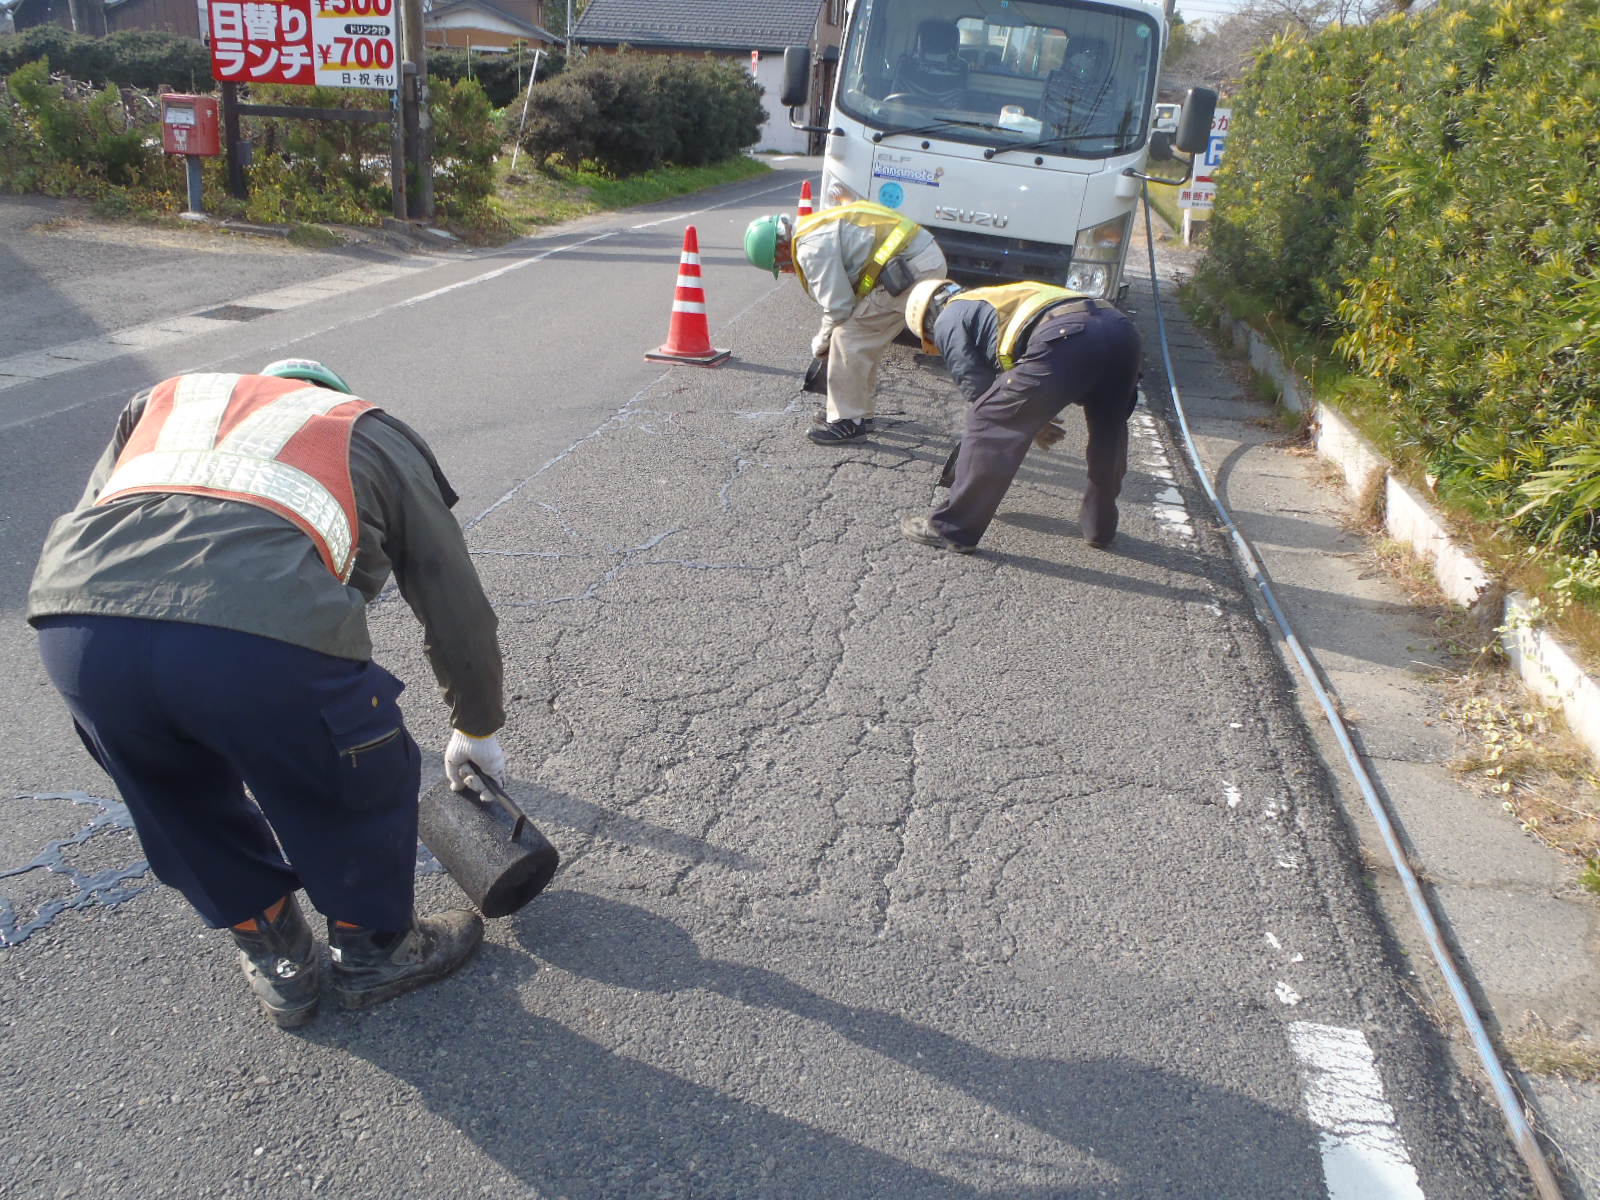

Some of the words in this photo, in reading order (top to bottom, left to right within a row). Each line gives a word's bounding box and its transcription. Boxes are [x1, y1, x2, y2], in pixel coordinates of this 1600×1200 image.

[212, 2, 307, 42] 日替り
[350, 25, 386, 35] ドリンク付
[215, 42, 312, 79] ランチ
[317, 36, 394, 70] ¥700
[935, 205, 1008, 229] ISUZU
